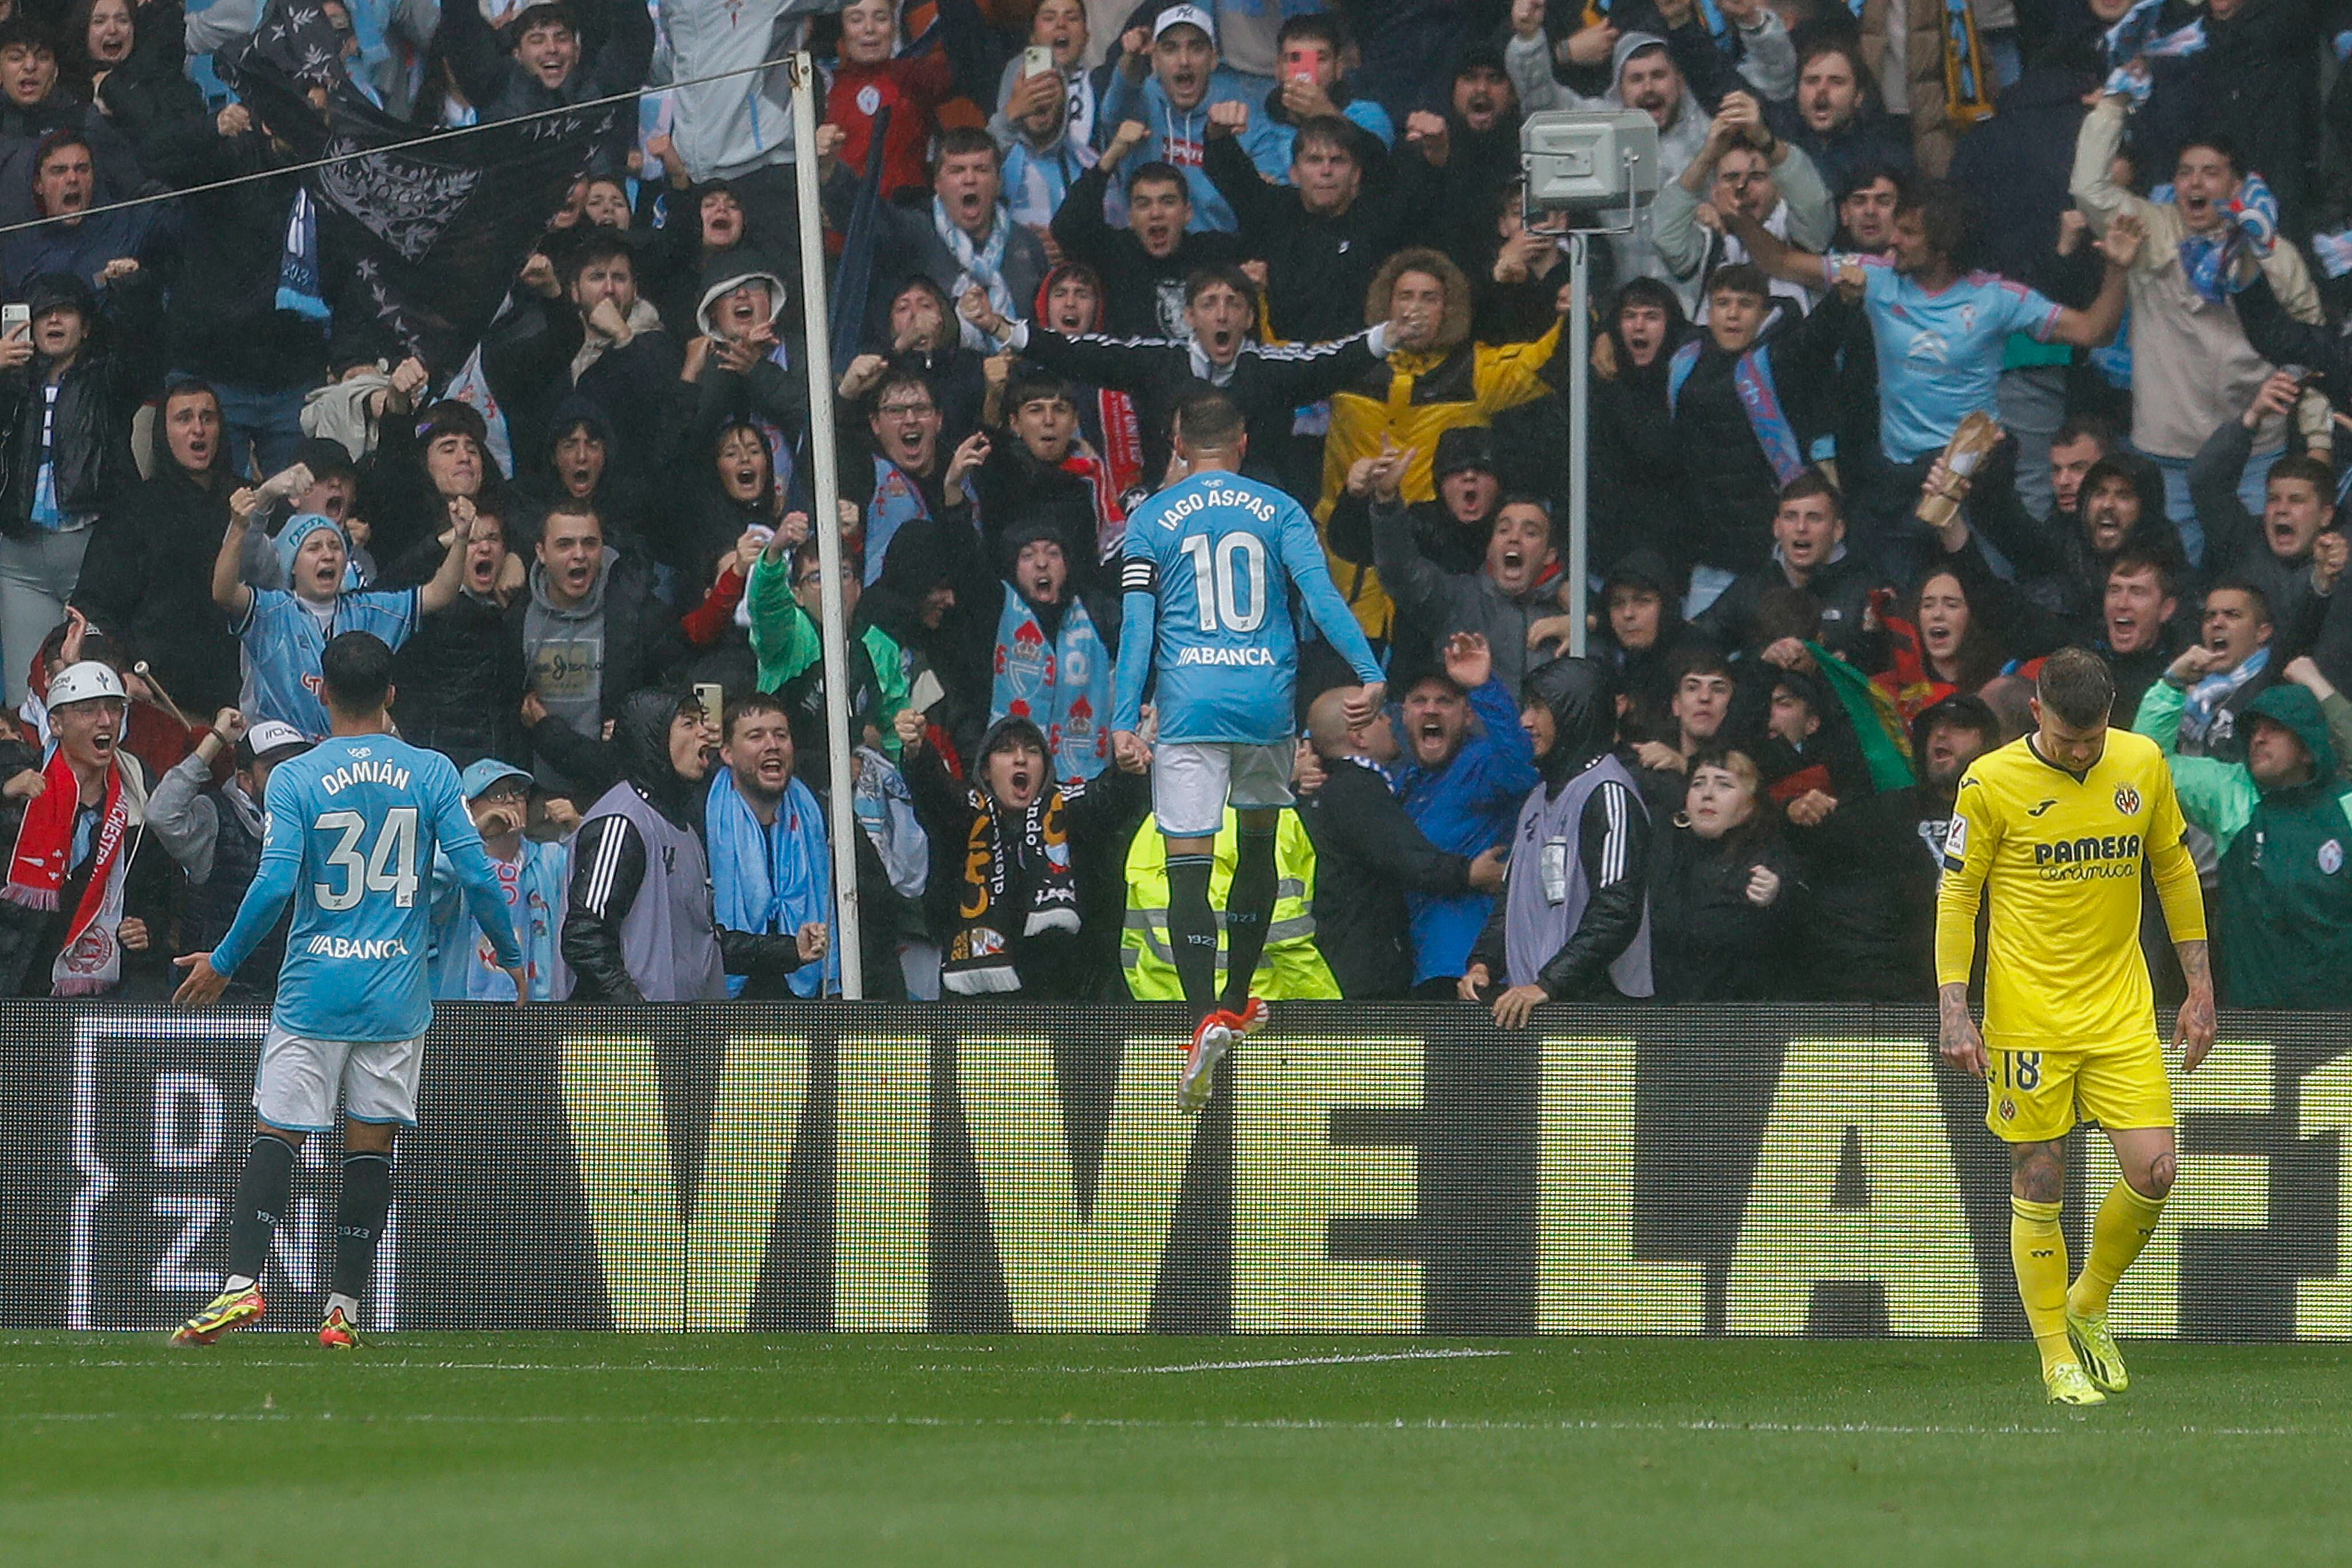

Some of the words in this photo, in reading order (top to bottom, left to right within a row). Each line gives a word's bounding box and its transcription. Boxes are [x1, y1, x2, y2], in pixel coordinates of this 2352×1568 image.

[1157, 493, 1204, 531] IAGO
[1208, 489, 1276, 523] ASPAS
[1180, 531, 1266, 633] 10
[321, 759, 411, 797] DAMIÁN
[1917, 820, 1949, 837] CE
[313, 806, 419, 912] 34
[2034, 834, 2140, 865] PAMESA
[2002, 1051, 2041, 1092] 18
[559, 1035, 1426, 1332] VIVE
[1537, 1037, 1982, 1338] LA
